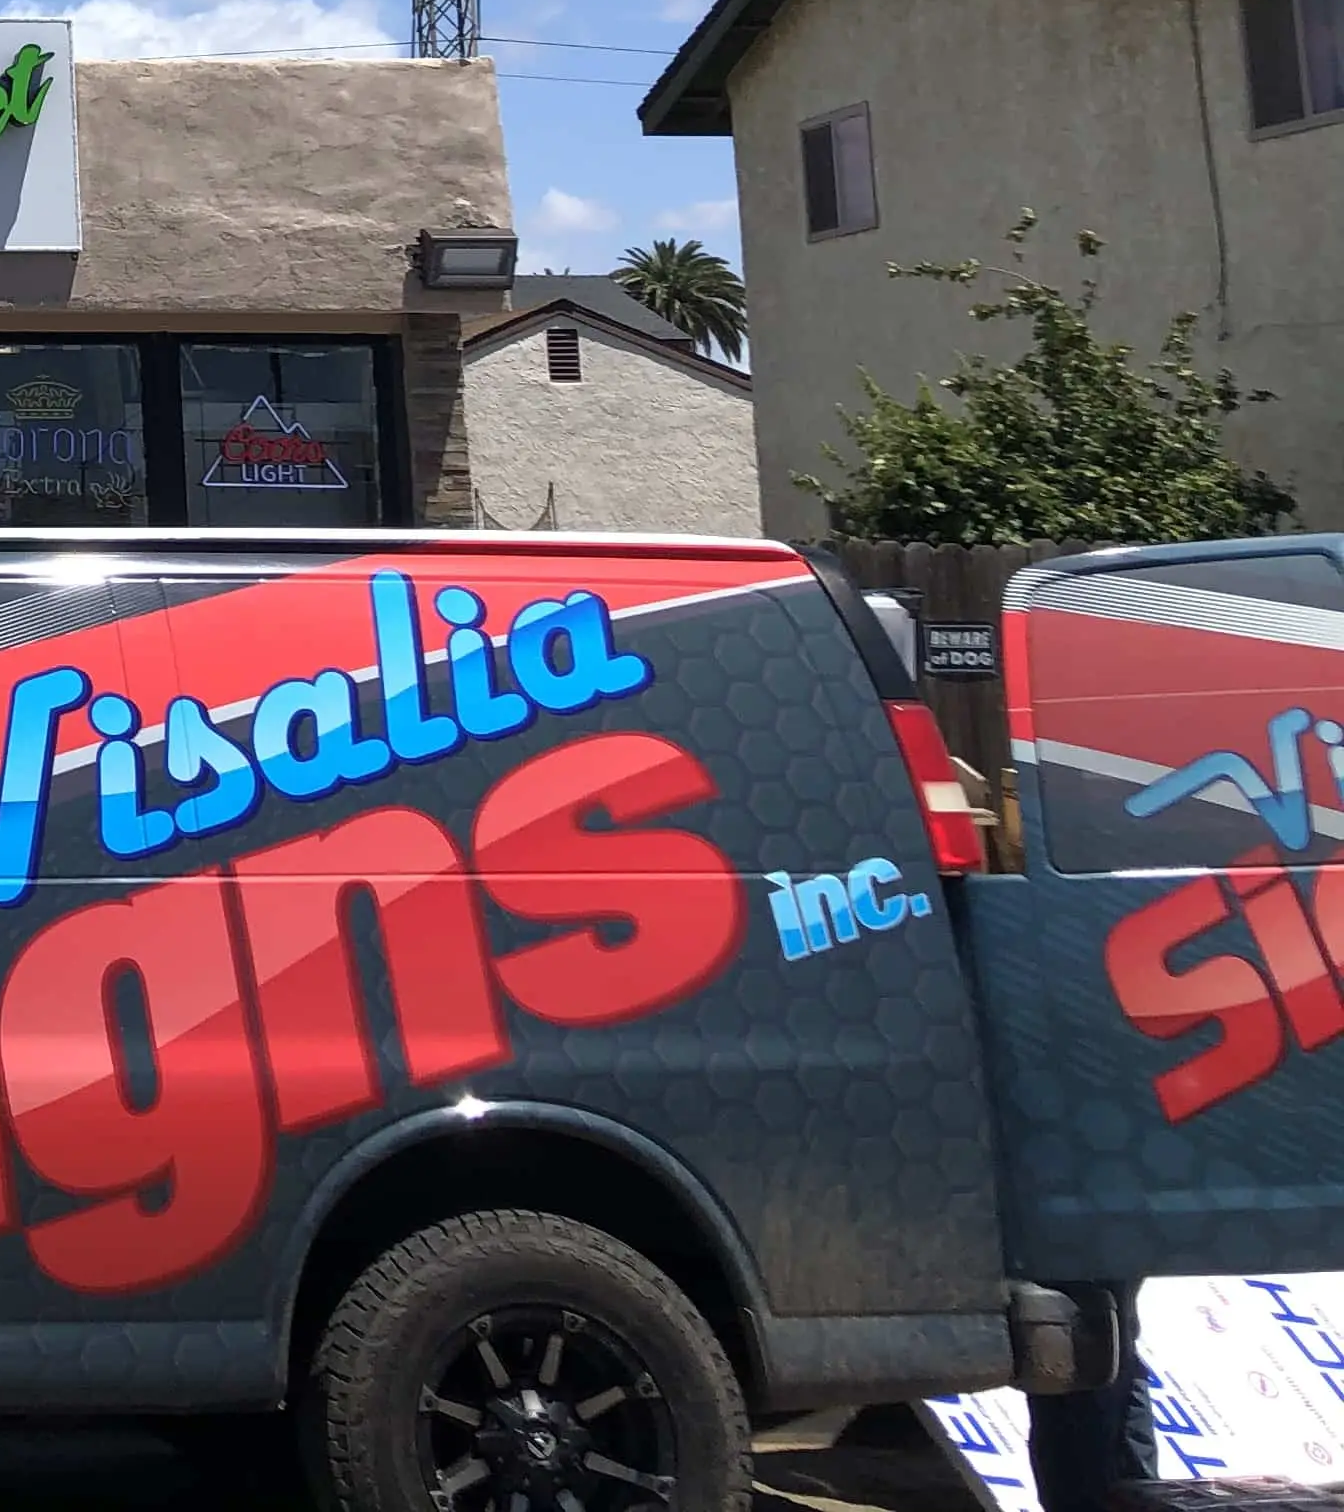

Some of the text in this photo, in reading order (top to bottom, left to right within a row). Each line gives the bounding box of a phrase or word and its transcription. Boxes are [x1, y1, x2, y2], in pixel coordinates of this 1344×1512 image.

[4, 470, 82, 498] Extra
[241, 463, 308, 483] LIGHT
[950, 651, 993, 665] DOG
[765, 856, 933, 963] inc.
